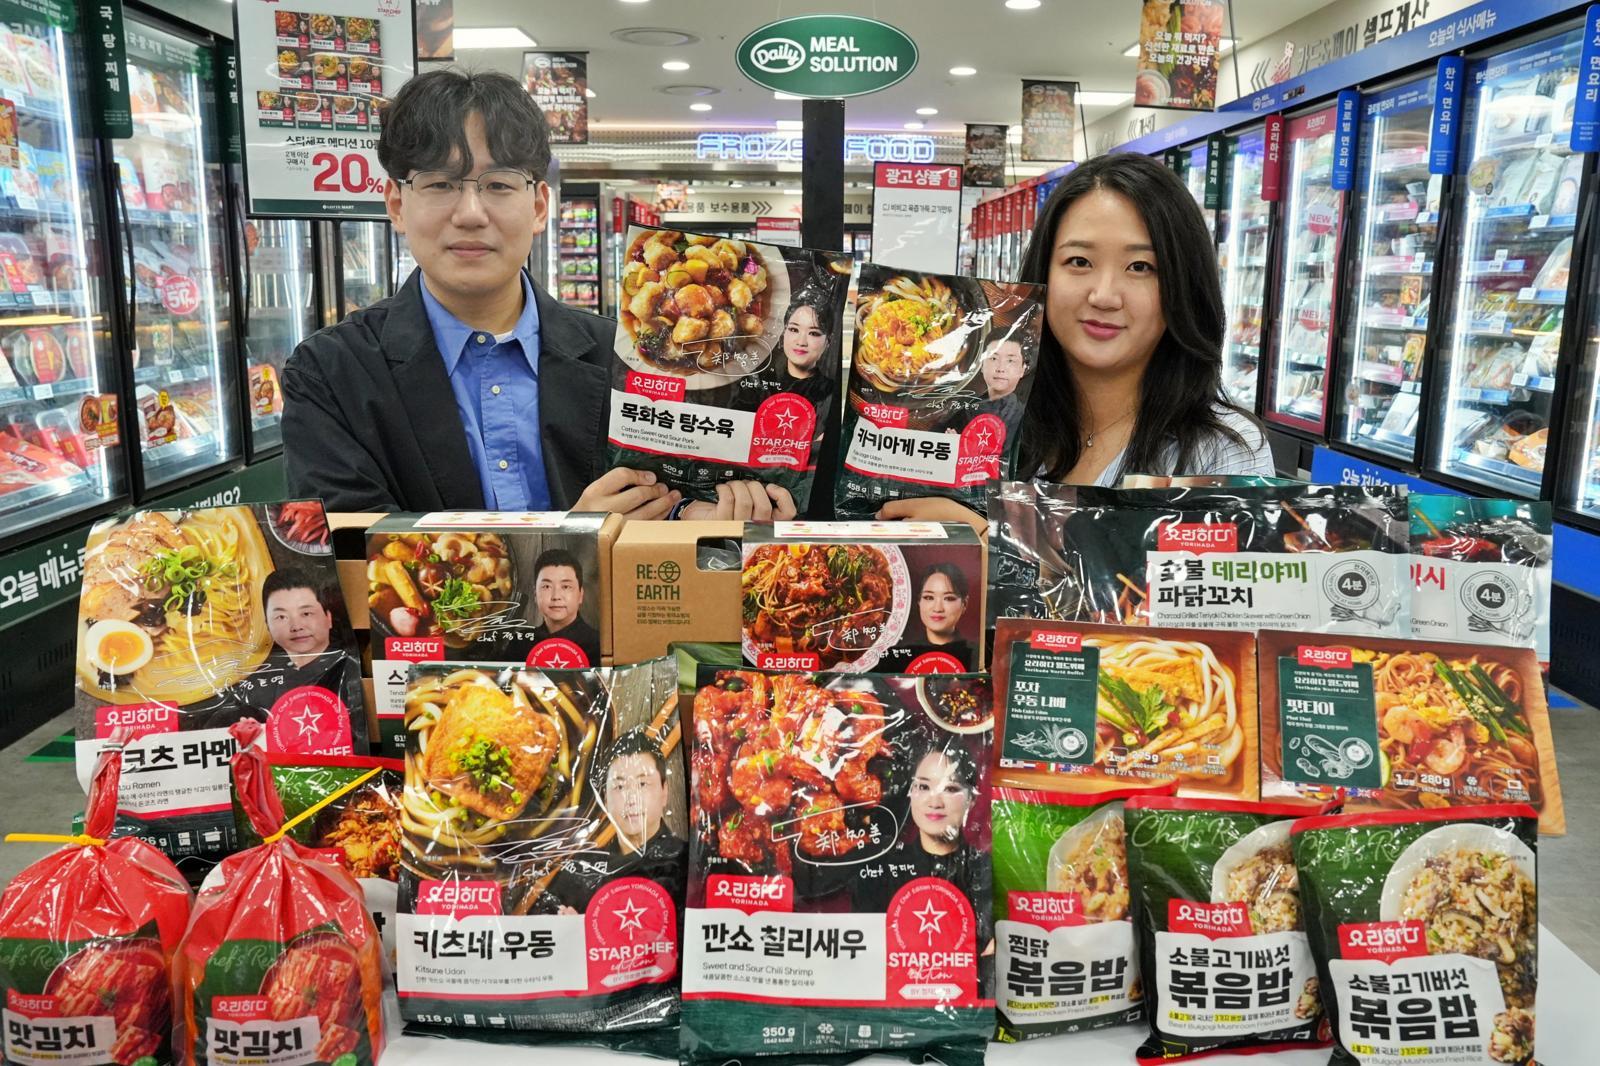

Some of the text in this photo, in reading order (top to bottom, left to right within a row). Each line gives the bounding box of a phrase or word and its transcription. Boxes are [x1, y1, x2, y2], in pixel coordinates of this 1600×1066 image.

[1428, 9, 1497, 48] 오늘의 식사메뉴
[809, 37, 860, 53] MEAL
[757, 43, 800, 66] Daily
[809, 56, 898, 72] SOLUTION
[1440, 67, 1455, 136] 한식 면요리
[697, 133, 804, 160] FROZE
[844, 138, 935, 163] FOOD
[1269, 122, 1279, 163] 요리하다
[312, 152, 384, 193] 20%
[886, 168, 942, 186] 광고 상품
[710, 202, 750, 213] 보수용품
[1309, 213, 1331, 223] NEW
[631, 376, 681, 393] 요리하다
[620, 402, 735, 439] 목화솜 탕수육
[863, 406, 904, 421] 요리하다
[621, 425, 640, 434] Cotton
[641, 429, 657, 437] Sweet
[752, 437, 811, 450] STAR CHEF
[857, 427, 951, 461] 카키아게 우동
[662, 463, 677, 473] 500
[957, 456, 979, 465] STAR
[1165, 528, 1231, 543] 요리하다
[637, 564, 657, 579] RE:
[1212, 560, 1308, 583] 데리야끼
[0, 569, 40, 608] 오늘
[1341, 577, 1364, 591] 4분
[637, 585, 680, 600] EARTH
[1157, 585, 1253, 608] 파닭꼬치
[1480, 588, 1502, 603] 4분
[1412, 618, 1448, 627] Green Onion
[477, 631, 498, 642] chef
[1036, 633, 1078, 645] 요리하다
[390, 641, 439, 653] 요리하다
[1303, 649, 1348, 661] 요리하다
[763, 657, 814, 669] 요리하다
[1024, 660, 1054, 668] 요리하다
[1014, 680, 1041, 693] 포차
[1294, 677, 1326, 685] 요리하다
[1013, 693, 1039, 707] 우동
[1287, 698, 1335, 716] 팟타이
[104, 707, 170, 726] 요리하다
[122, 737, 237, 774] 코츠 라멘
[132, 780, 161, 790] Ramen
[428, 886, 495, 903] 요리하다
[714, 879, 787, 900] 요리하다
[730, 898, 769, 906] YORIHADA
[1015, 896, 1075, 915] 요리하다
[1176, 904, 1243, 925] 요리하다
[1192, 922, 1233, 933] YORIHADA
[413, 929, 556, 960] 키츠네 우동
[701, 923, 867, 960] 깐쇼 칠리새우
[1347, 927, 1419, 947] 요리하다
[588, 941, 674, 961] STAR CHEF
[1008, 934, 1050, 958] 찜닭
[1366, 945, 1408, 954] YORIHADA
[888, 952, 974, 967] STAR CHEF
[1168, 944, 1291, 970] 소불고기버섯
[415, 965, 466, 976] Kitsune Udon
[702, 962, 814, 977] Sweet and Sour Chili Shrimp
[1007, 956, 1129, 998] 볶음밥
[1168, 966, 1293, 1009] 볶음밥
[1348, 968, 1470, 995] 소불고기버섯
[217, 1000, 267, 1012] 요리하다
[417, 1014, 452, 1024] 518 g
[1350, 993, 1480, 1042] 볶음밥
[9, 1020, 96, 1051] 맛김치
[762, 1026, 796, 1037] 350 g
[214, 1027, 303, 1057] 맛김치
